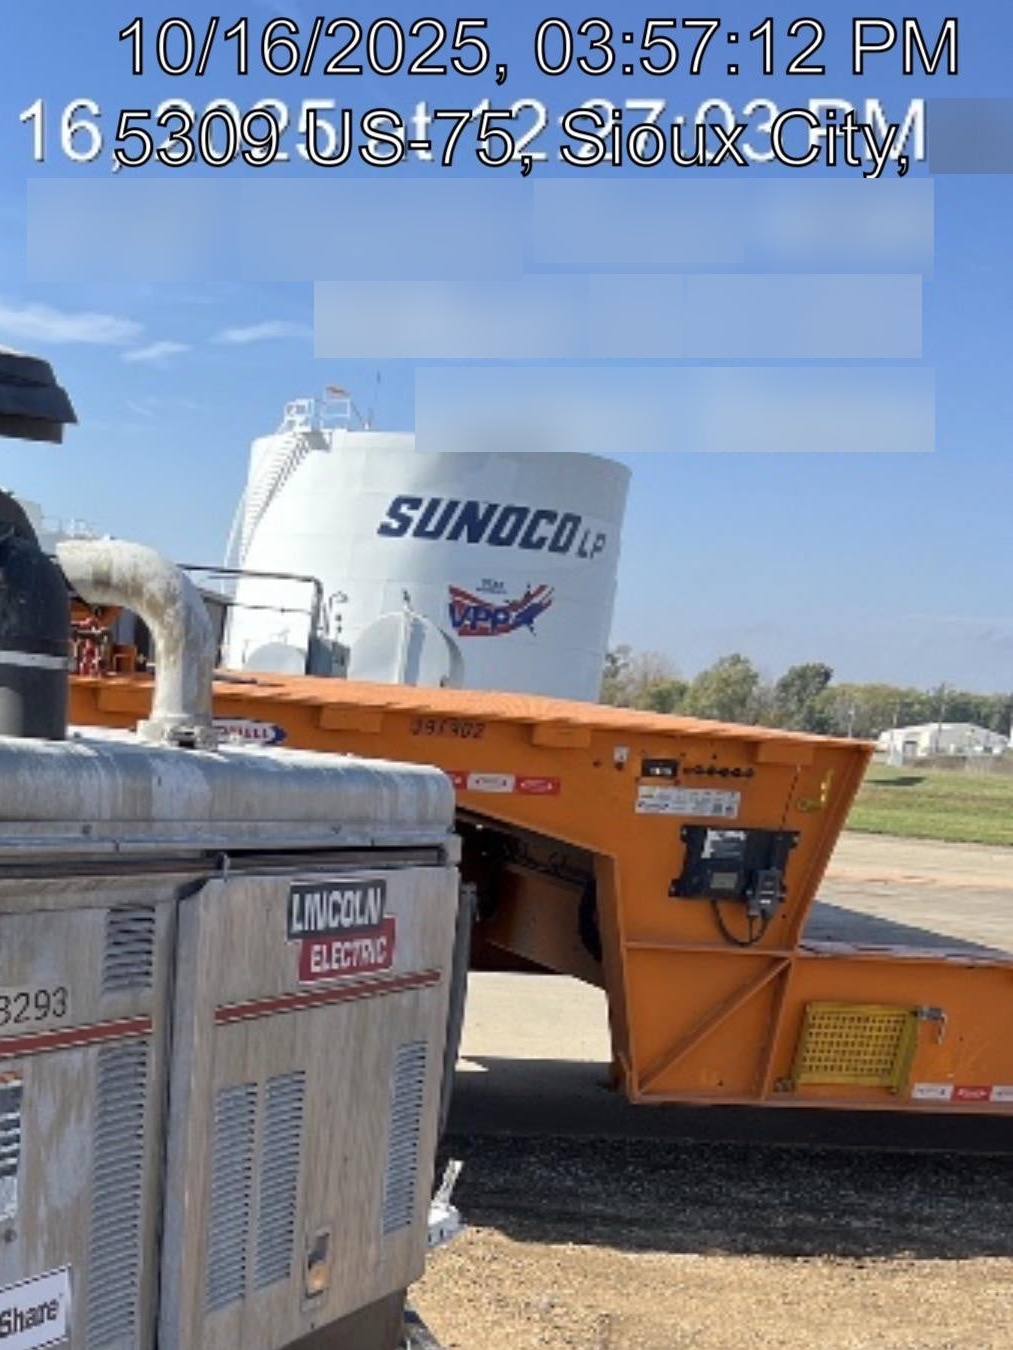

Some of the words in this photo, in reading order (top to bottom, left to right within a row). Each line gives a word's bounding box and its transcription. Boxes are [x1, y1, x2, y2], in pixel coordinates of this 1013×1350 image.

[376, 494, 583, 557] SUNOCO
[575, 528, 607, 560] LP
[290, 886, 383, 934] LINCOLN
[310, 935, 388, 974] ELECTRIC
